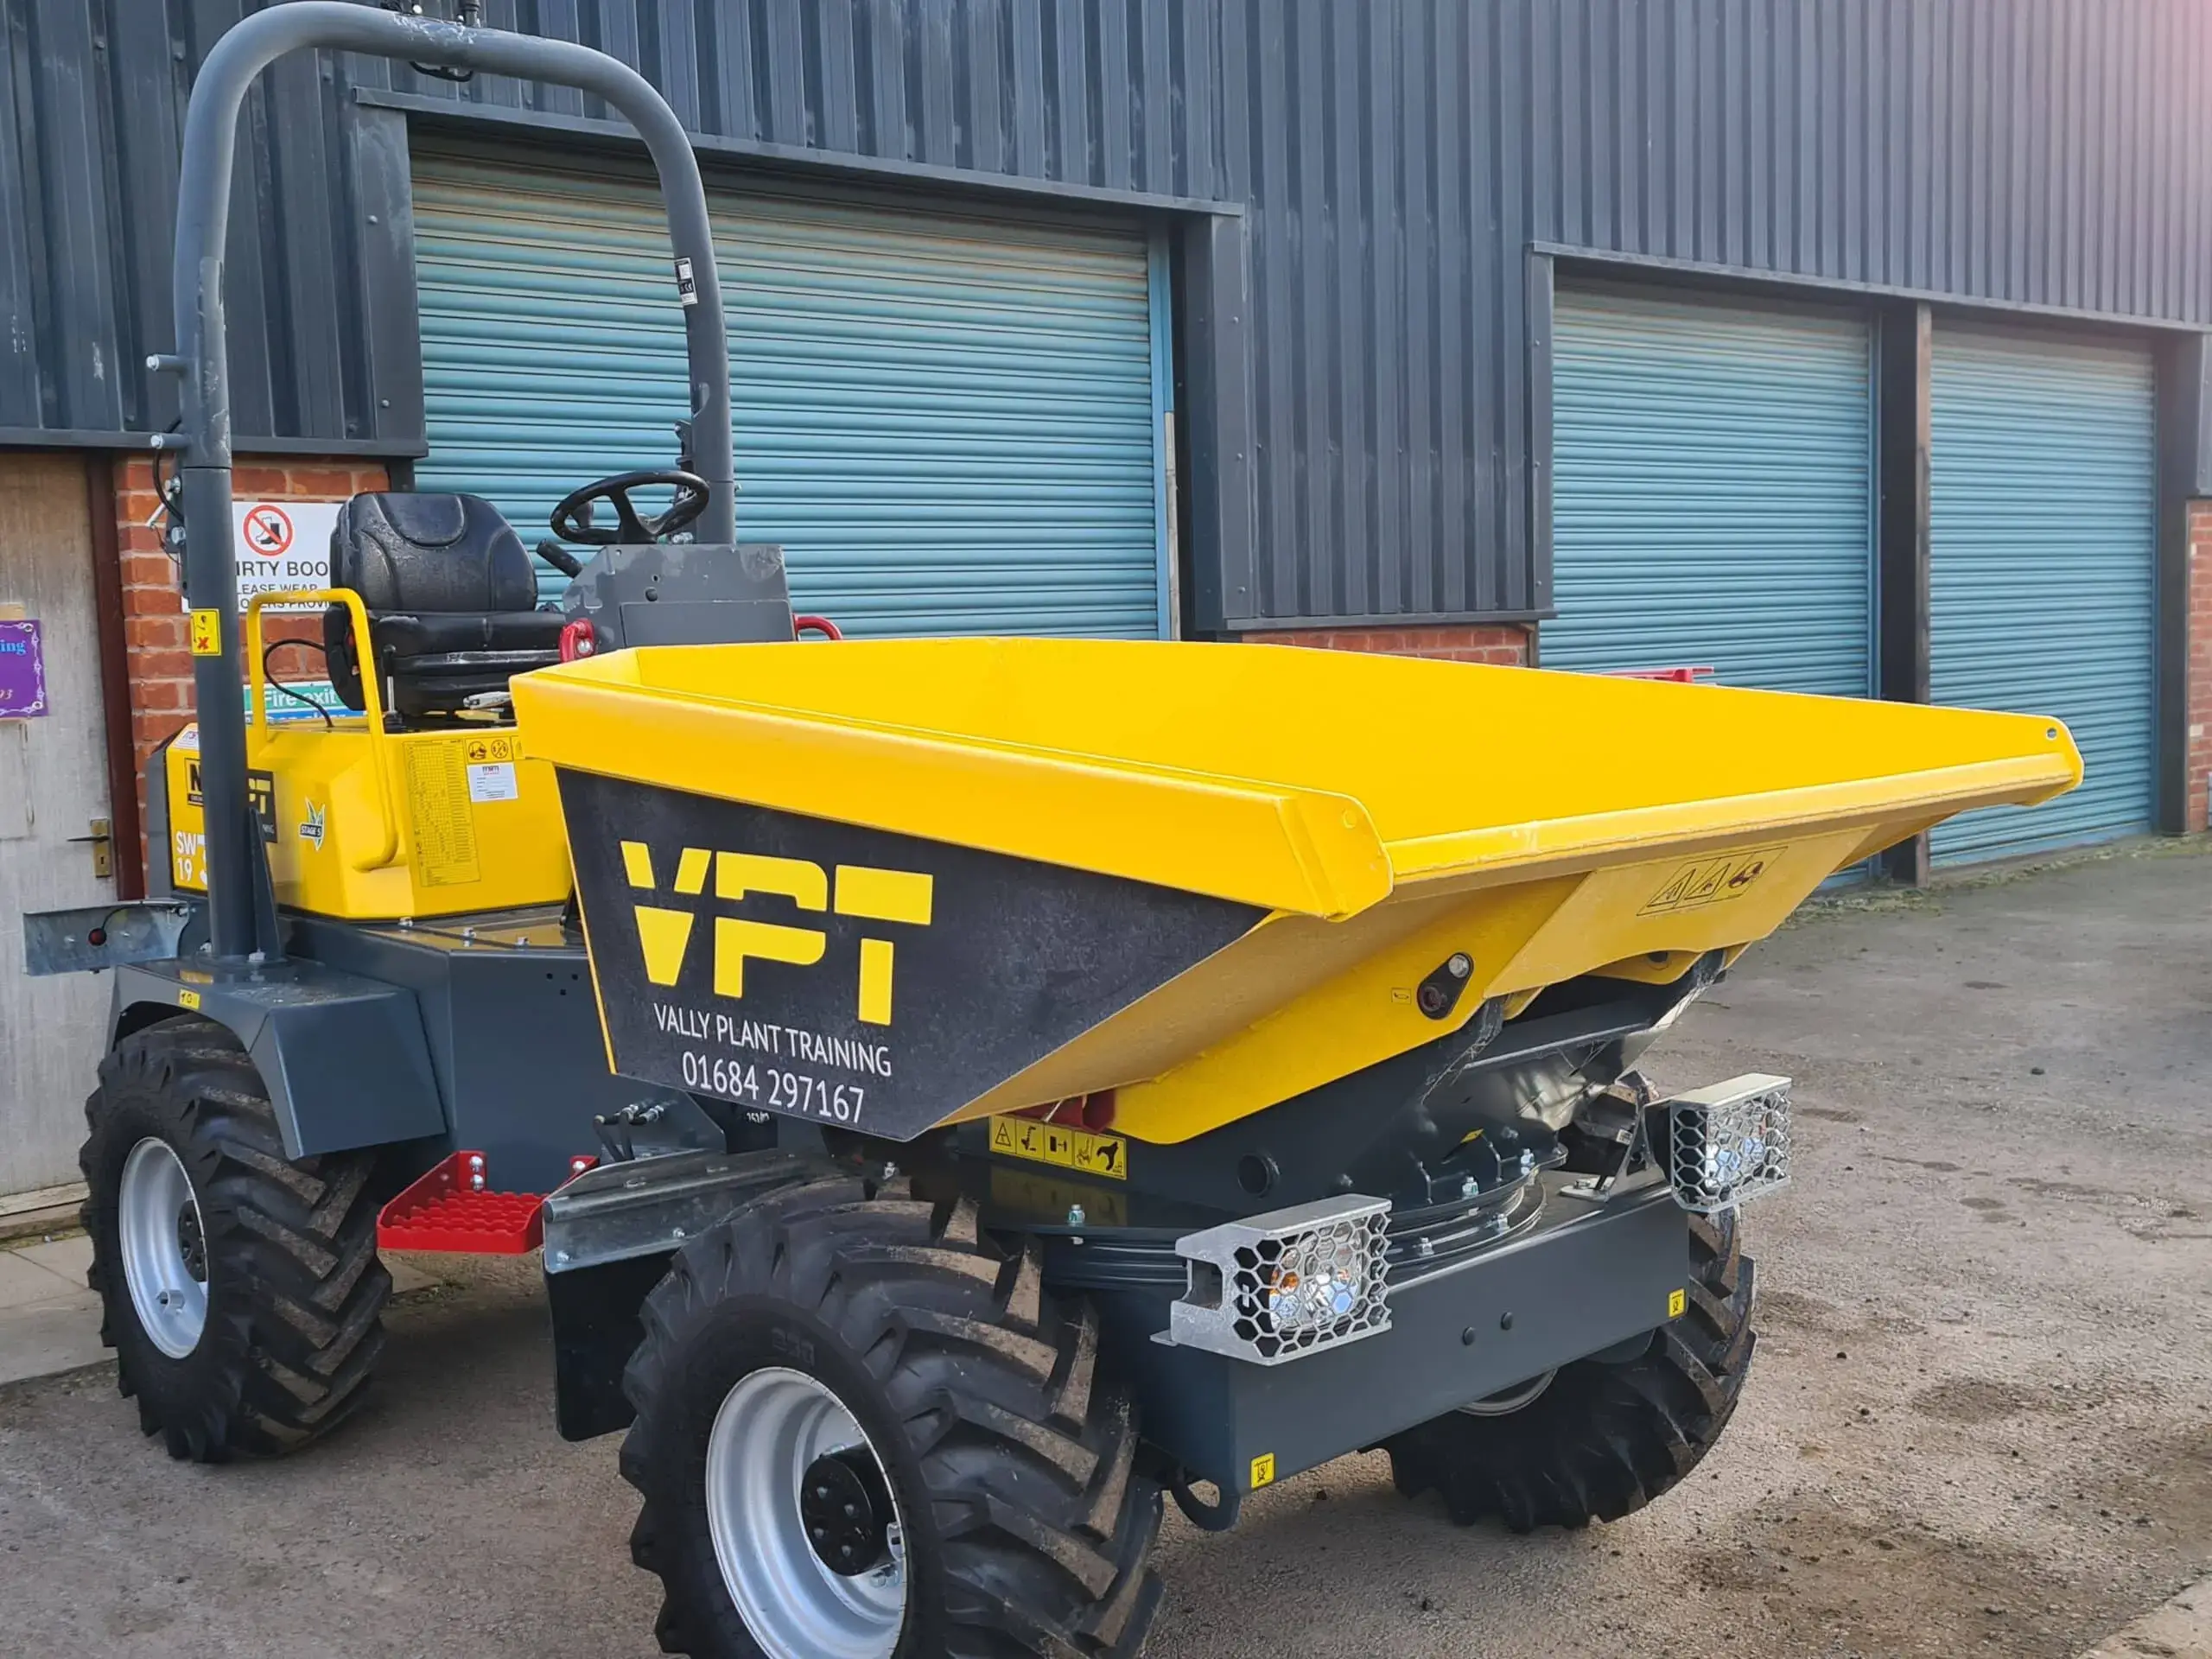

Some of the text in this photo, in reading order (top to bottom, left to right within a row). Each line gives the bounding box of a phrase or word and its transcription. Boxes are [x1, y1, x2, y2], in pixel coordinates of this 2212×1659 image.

[238, 583, 276, 594] EASE
[264, 690, 297, 706] Fire
[620, 840, 933, 1027] VPT
[653, 1002, 892, 1077] VALLY PLANT TRAINING
[682, 1051, 864, 1124] 01684 297167
